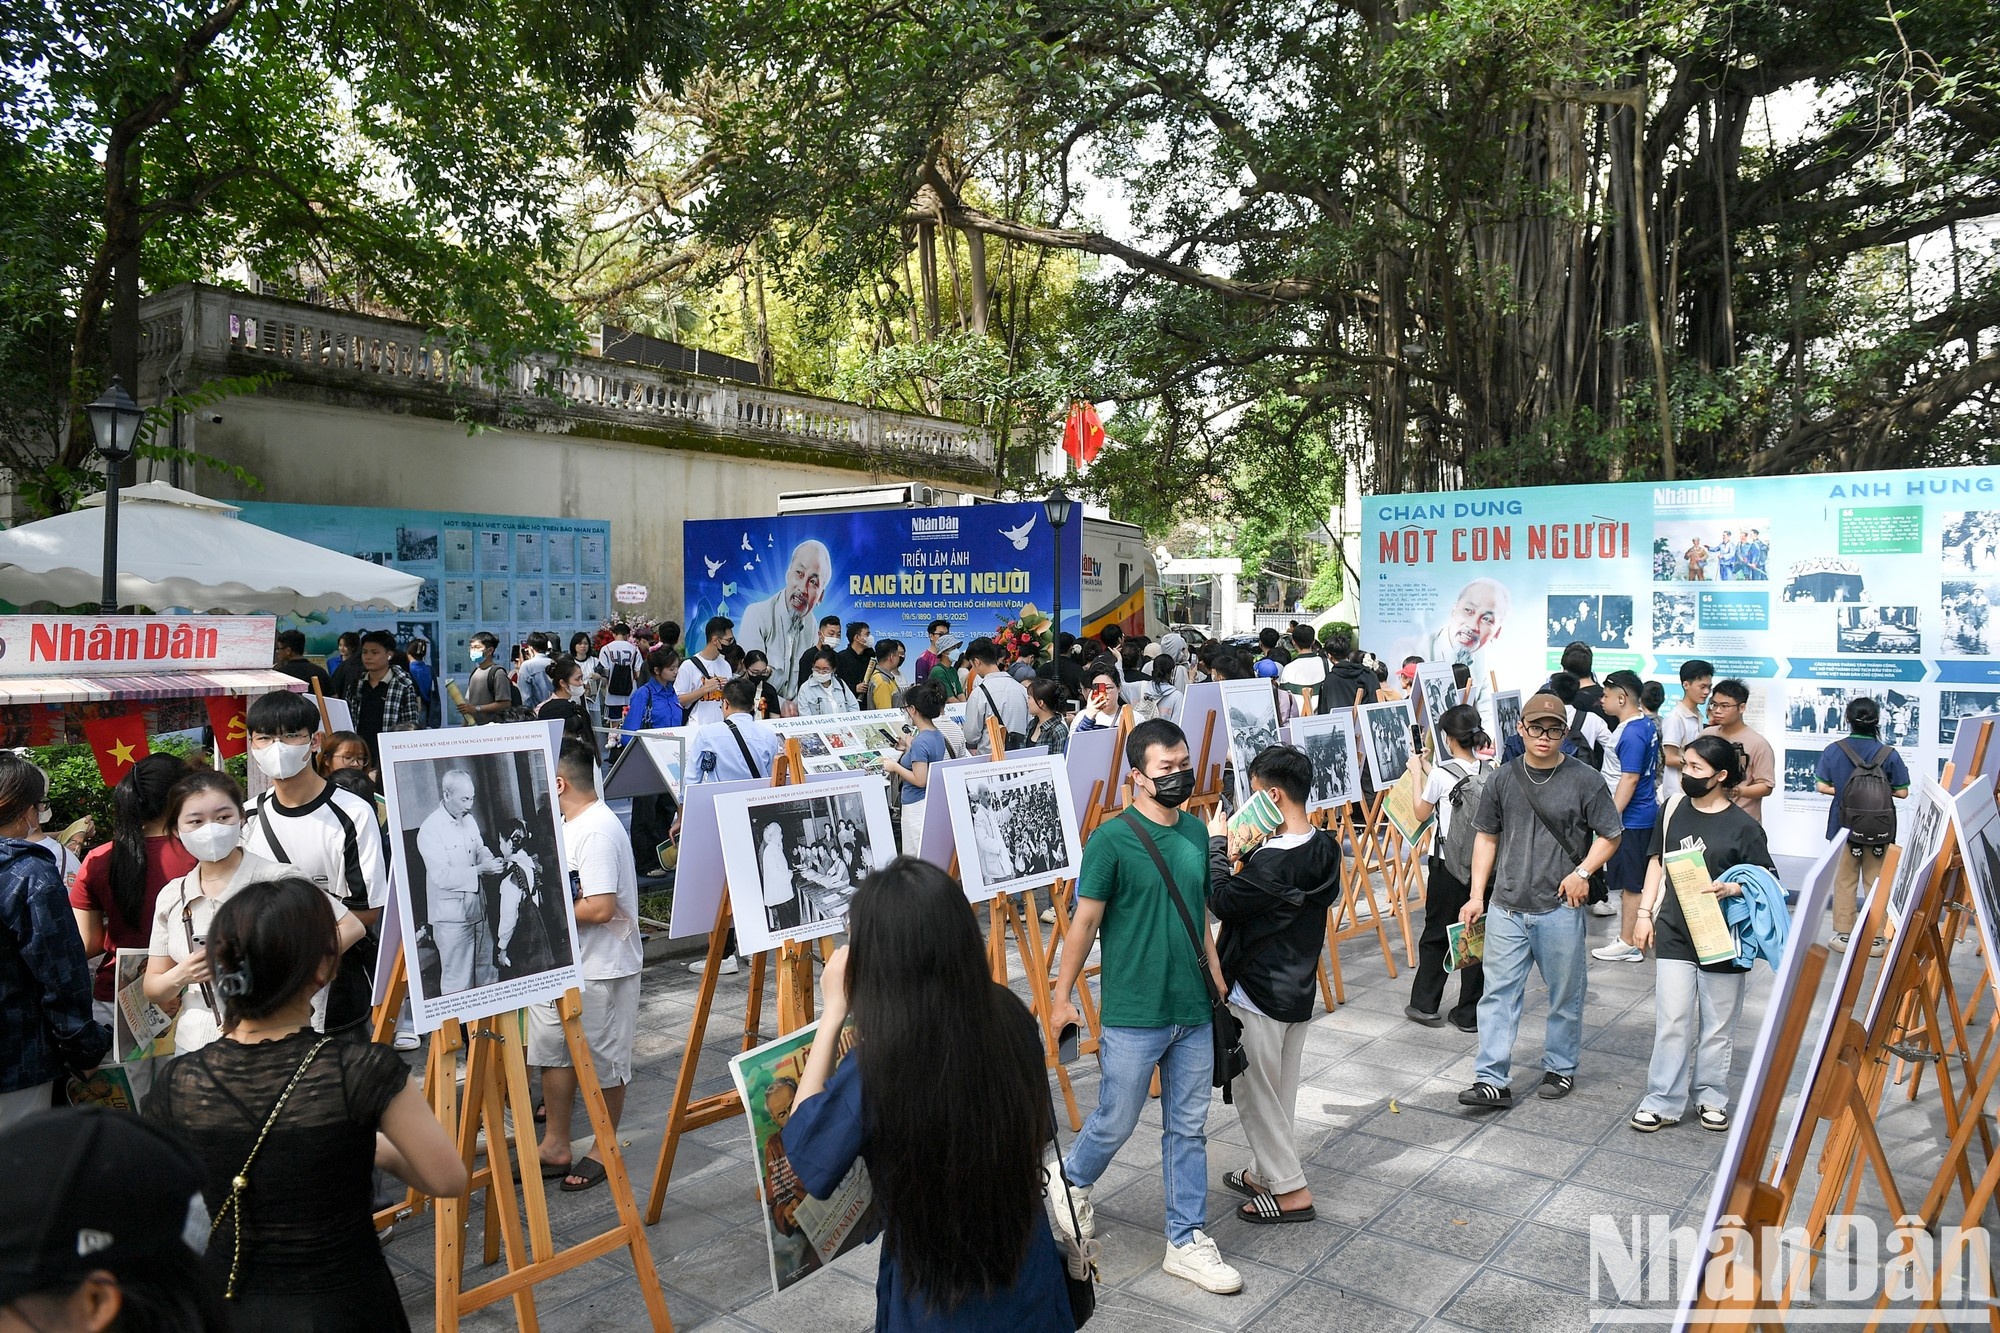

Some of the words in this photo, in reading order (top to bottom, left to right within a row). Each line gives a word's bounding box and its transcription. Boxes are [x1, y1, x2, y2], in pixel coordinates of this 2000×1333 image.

[1829, 482, 1890, 498] ANH
[1455, 500, 1522, 517] DUNG
[1379, 524, 1437, 566] MỘT
[1452, 526, 1511, 562] CON
[1528, 515, 1629, 559] NGƯỜI
[902, 548, 926, 567] TRIỂN
[930, 550, 948, 566] LÃM
[950, 549, 970, 566] ẢNH
[850, 574, 896, 598] RẠNG
[900, 570, 926, 594] RỠ
[929, 570, 966, 594] TÊN
[970, 568, 1030, 594] NGƯỜI
[901, 600, 917, 608] NGÀY
[933, 600, 946, 608] CHỦ
[964, 599, 973, 608] HỒ
[975, 599, 986, 608] CHÍ
